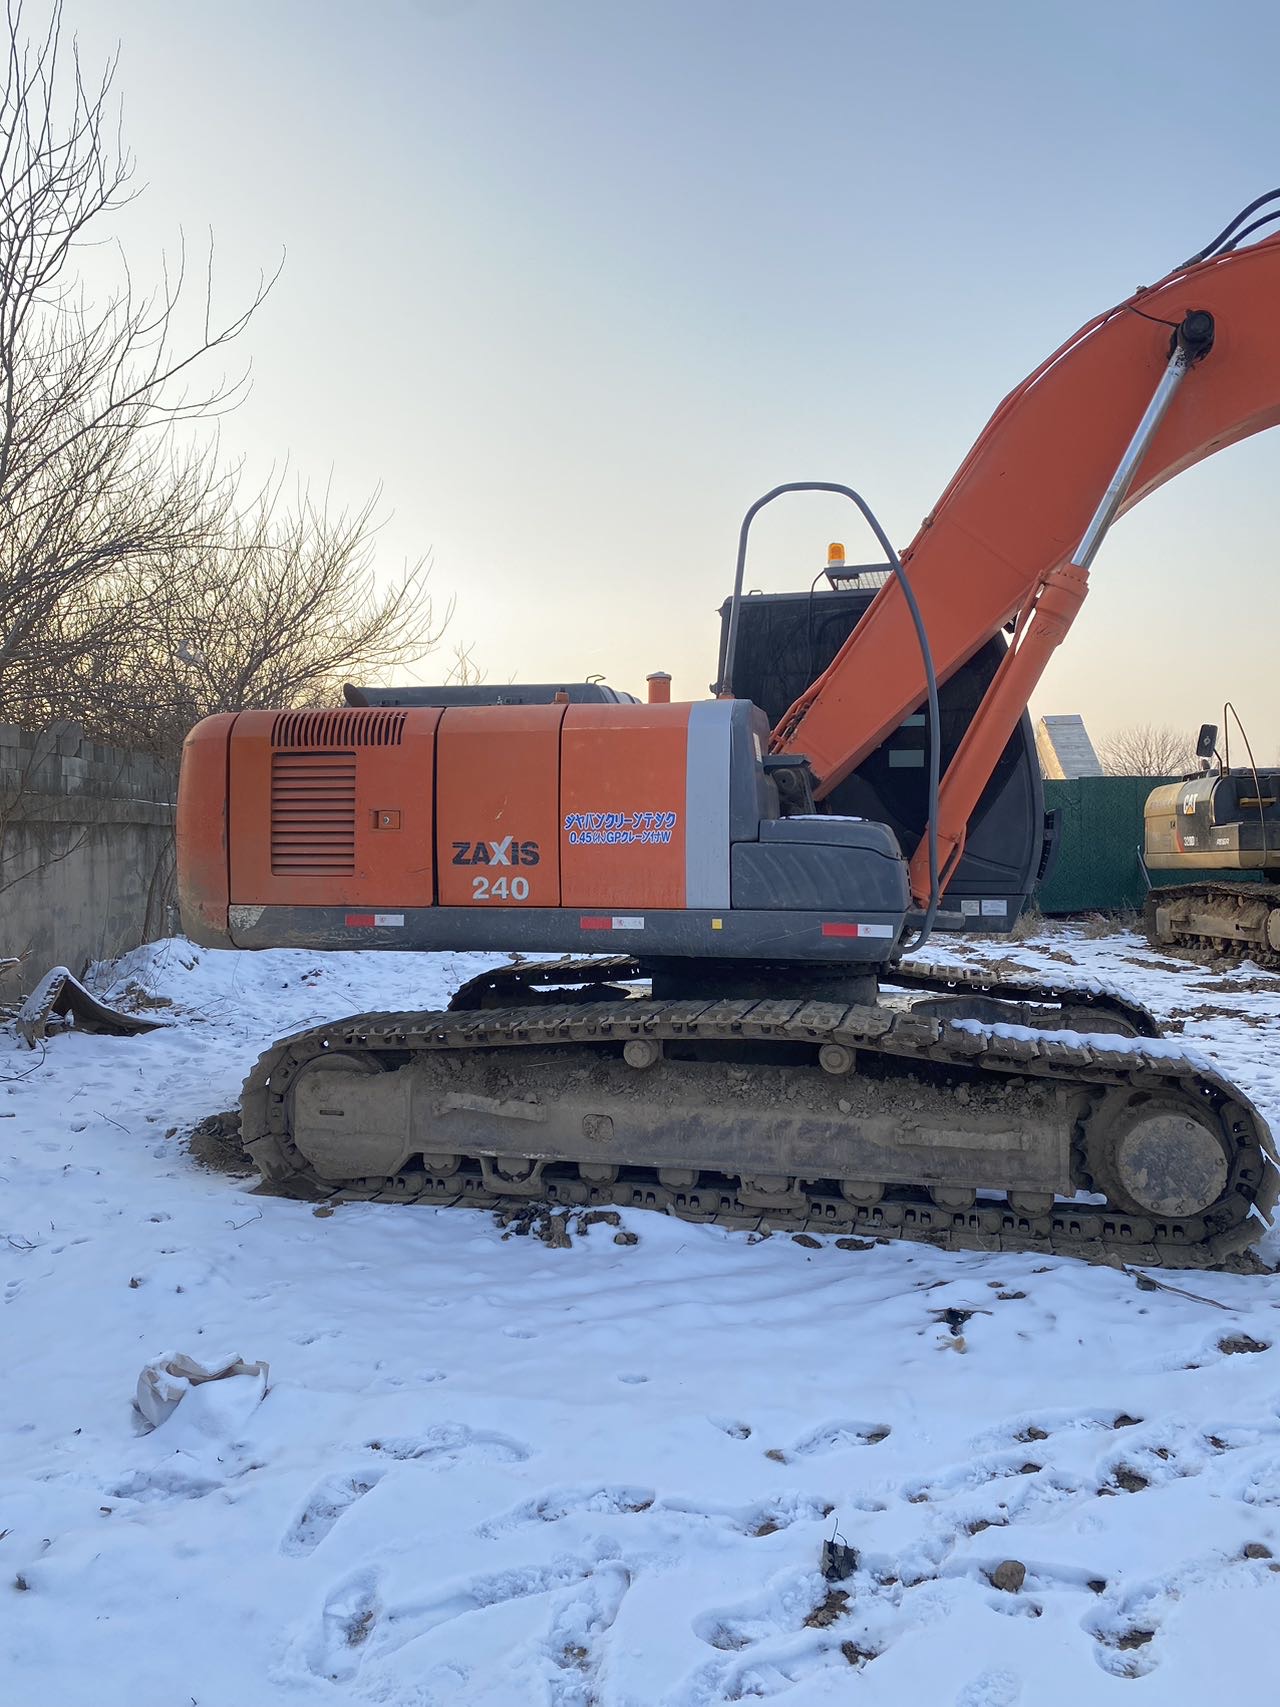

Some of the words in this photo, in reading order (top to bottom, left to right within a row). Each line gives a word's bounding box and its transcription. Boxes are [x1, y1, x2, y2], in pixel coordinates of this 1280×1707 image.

[1183, 793, 1199, 815] CAT
[452, 836, 540, 866] ZAXIS
[472, 877, 530, 900] 240
